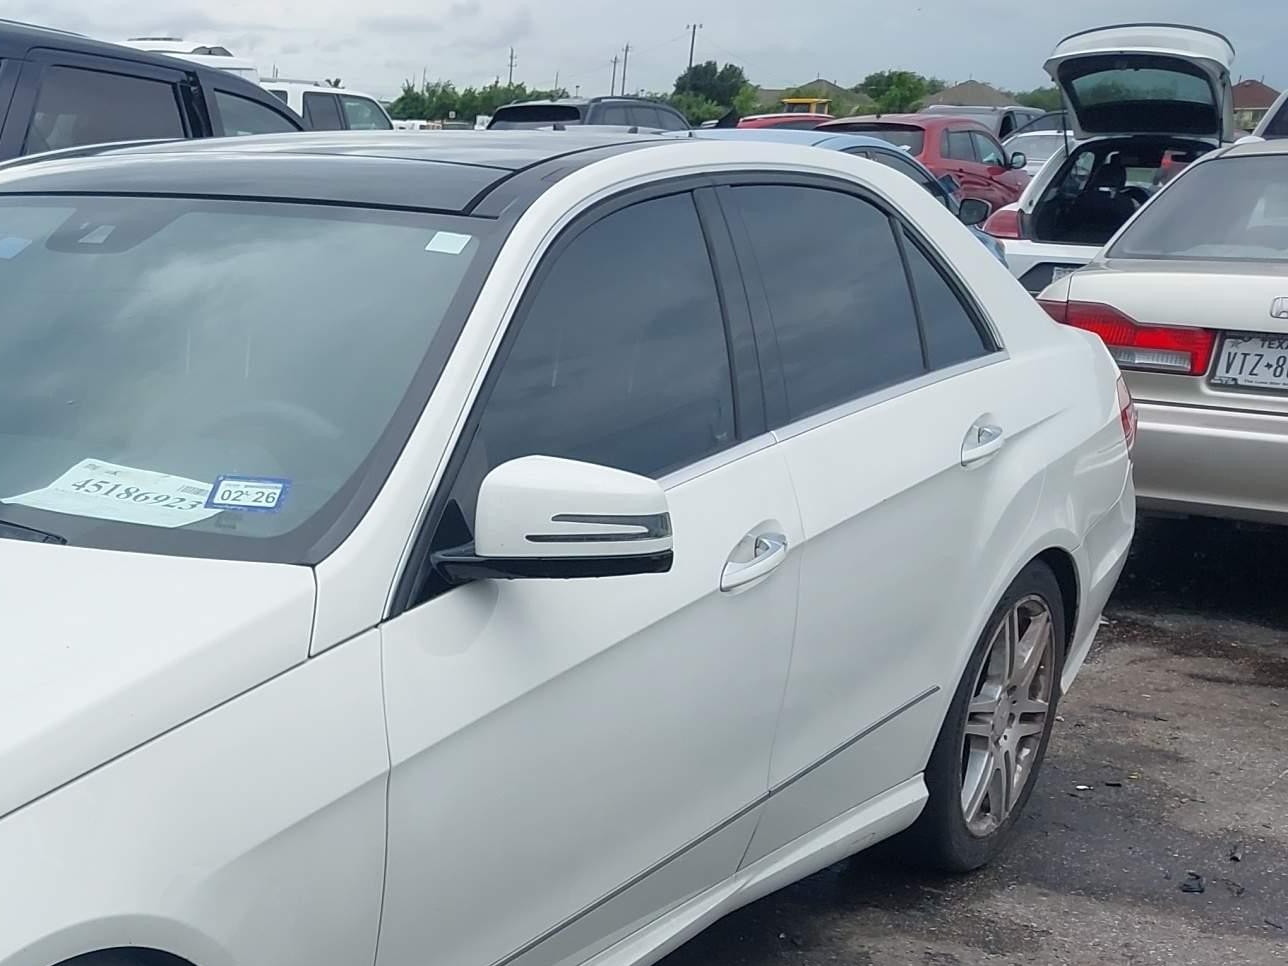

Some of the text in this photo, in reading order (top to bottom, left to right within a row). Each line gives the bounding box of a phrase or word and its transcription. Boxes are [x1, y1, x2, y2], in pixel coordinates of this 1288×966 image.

[71, 478, 204, 511] 45186923
[220, 489, 277, 504] 02 26
